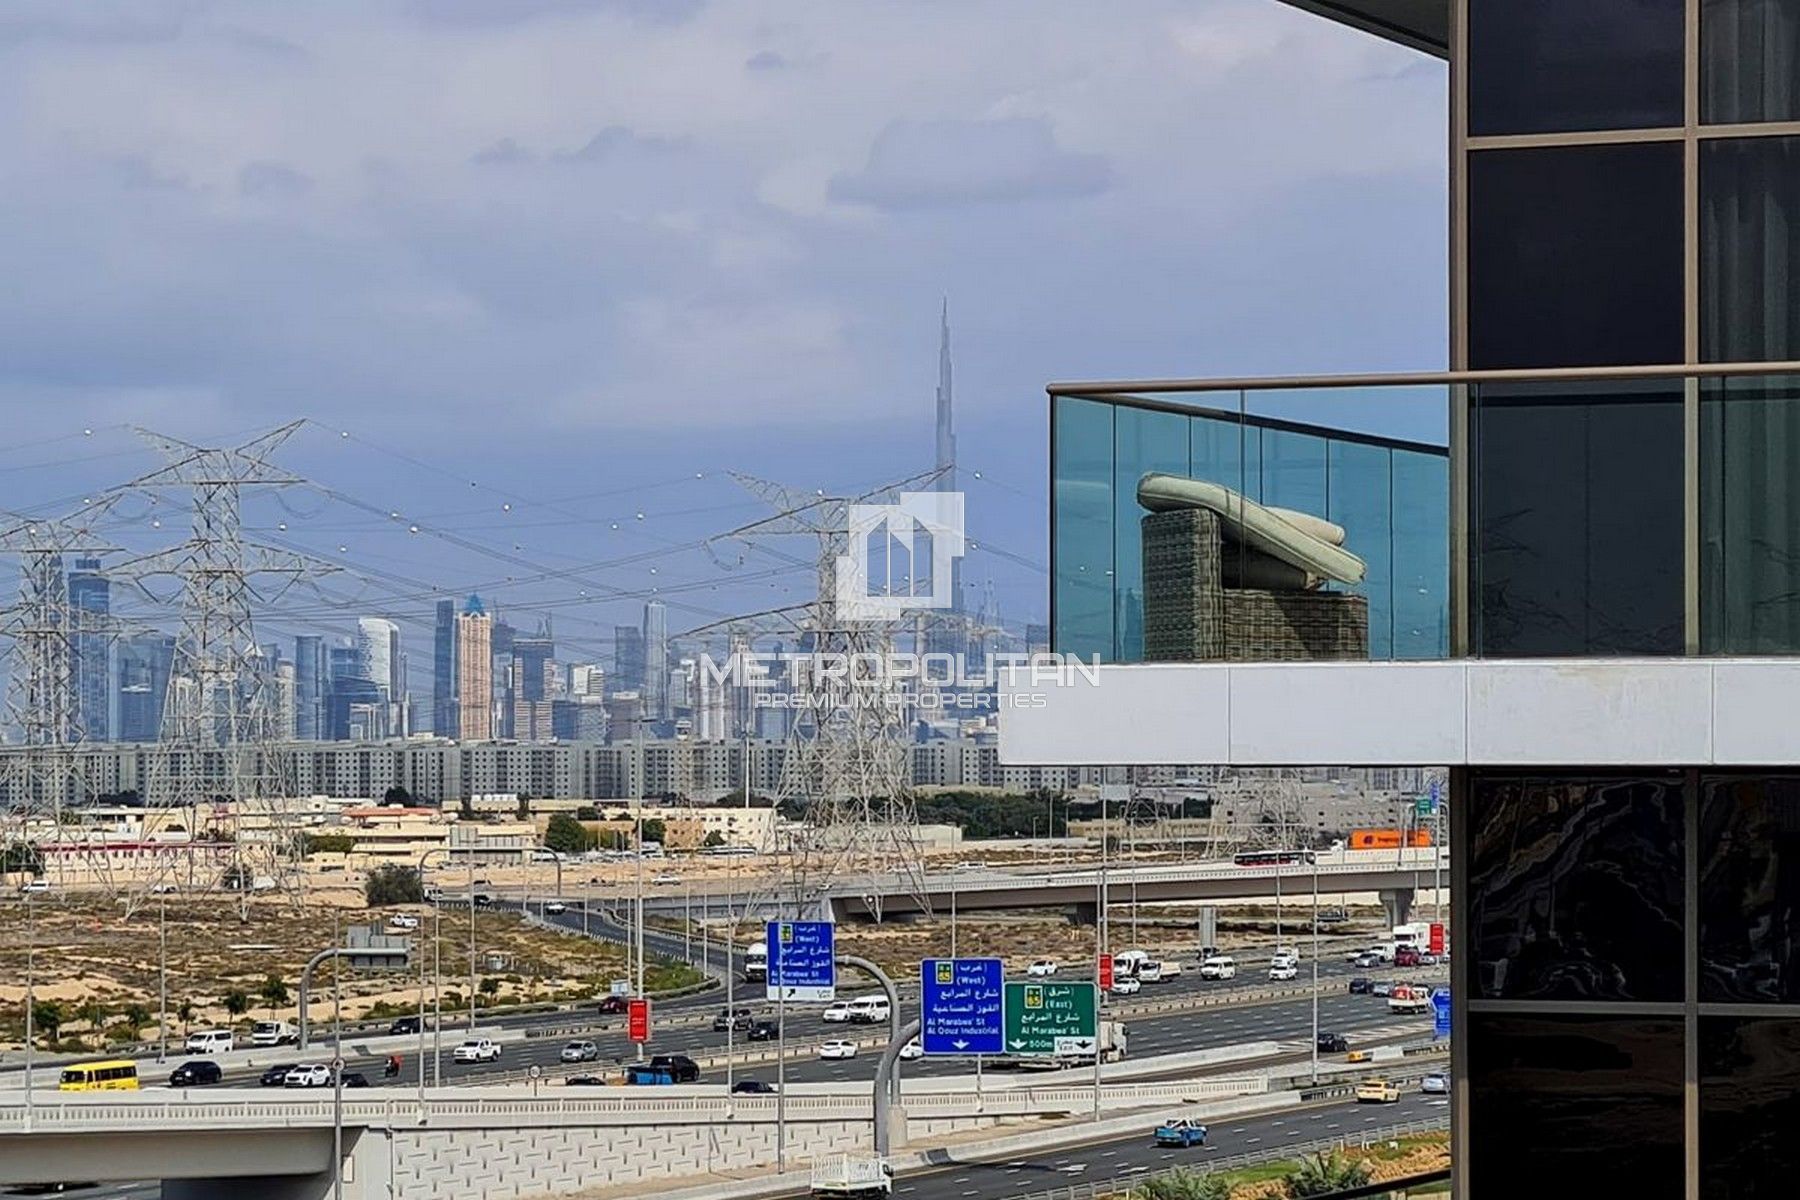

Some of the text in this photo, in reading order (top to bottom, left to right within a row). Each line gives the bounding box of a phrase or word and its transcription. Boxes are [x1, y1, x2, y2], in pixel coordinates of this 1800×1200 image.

[956, 976, 986, 986] (West)
[1045, 1000, 1073, 1010] (East)
[927, 1018, 936, 1026] Al
[976, 1018, 986, 1026] St
[927, 1027, 936, 1035] Al
[960, 1027, 999, 1035] Industrial
[1021, 1027, 1030, 1035] Al
[1070, 1027, 1080, 1035] St
